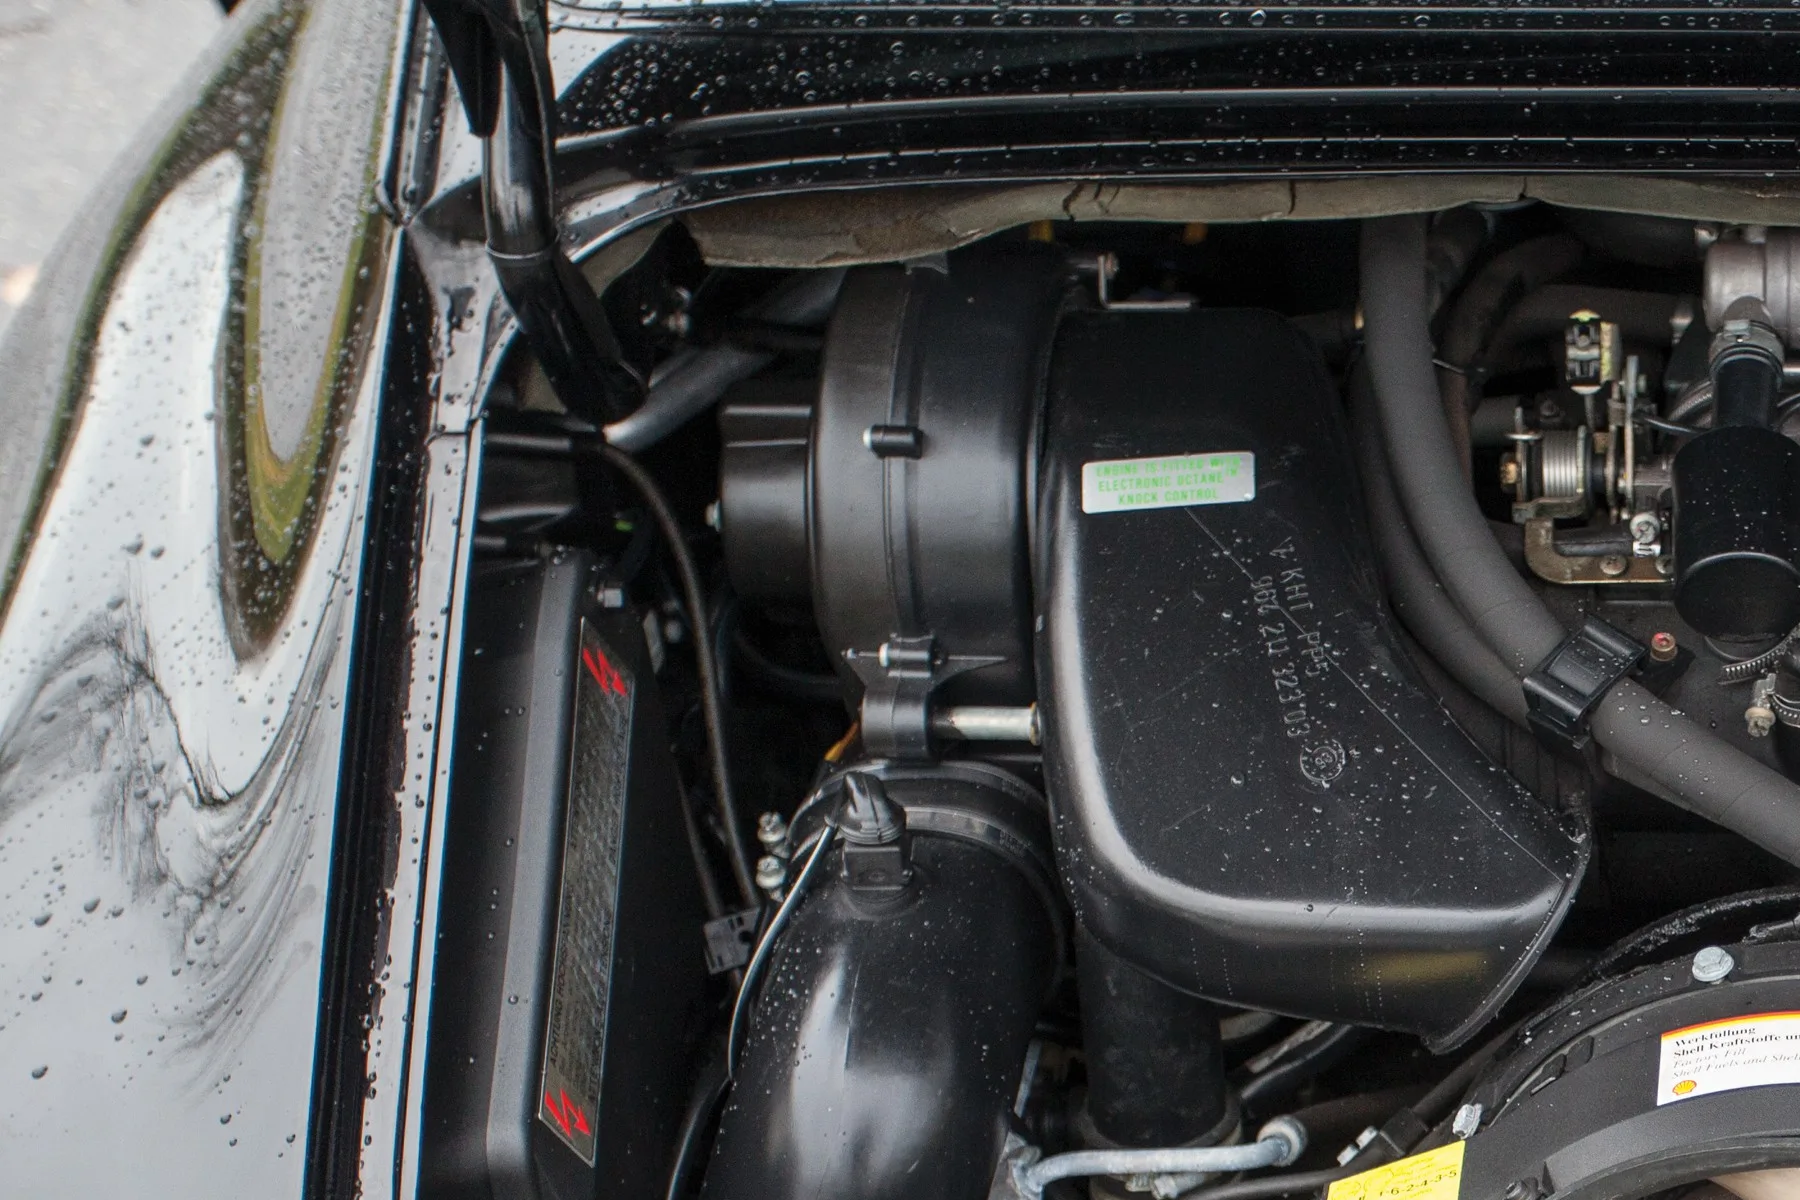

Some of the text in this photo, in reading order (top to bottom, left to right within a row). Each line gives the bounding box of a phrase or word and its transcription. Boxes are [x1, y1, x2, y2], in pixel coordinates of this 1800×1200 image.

[1098, 475, 1171, 492] ELECTRONIC
[1177, 472, 1224, 486] OCTANE
[1118, 488, 1218, 506] KNOCK CONTROL
[1674, 1026, 1756, 1047] Werkfüllung
[1674, 1044, 1705, 1057] Shell
[1709, 1033, 1782, 1050] Kraftstoffe
[1672, 1065, 1702, 1079] Shell
[1706, 1059, 1739, 1071] Fuels
[1743, 1053, 1767, 1065] and
